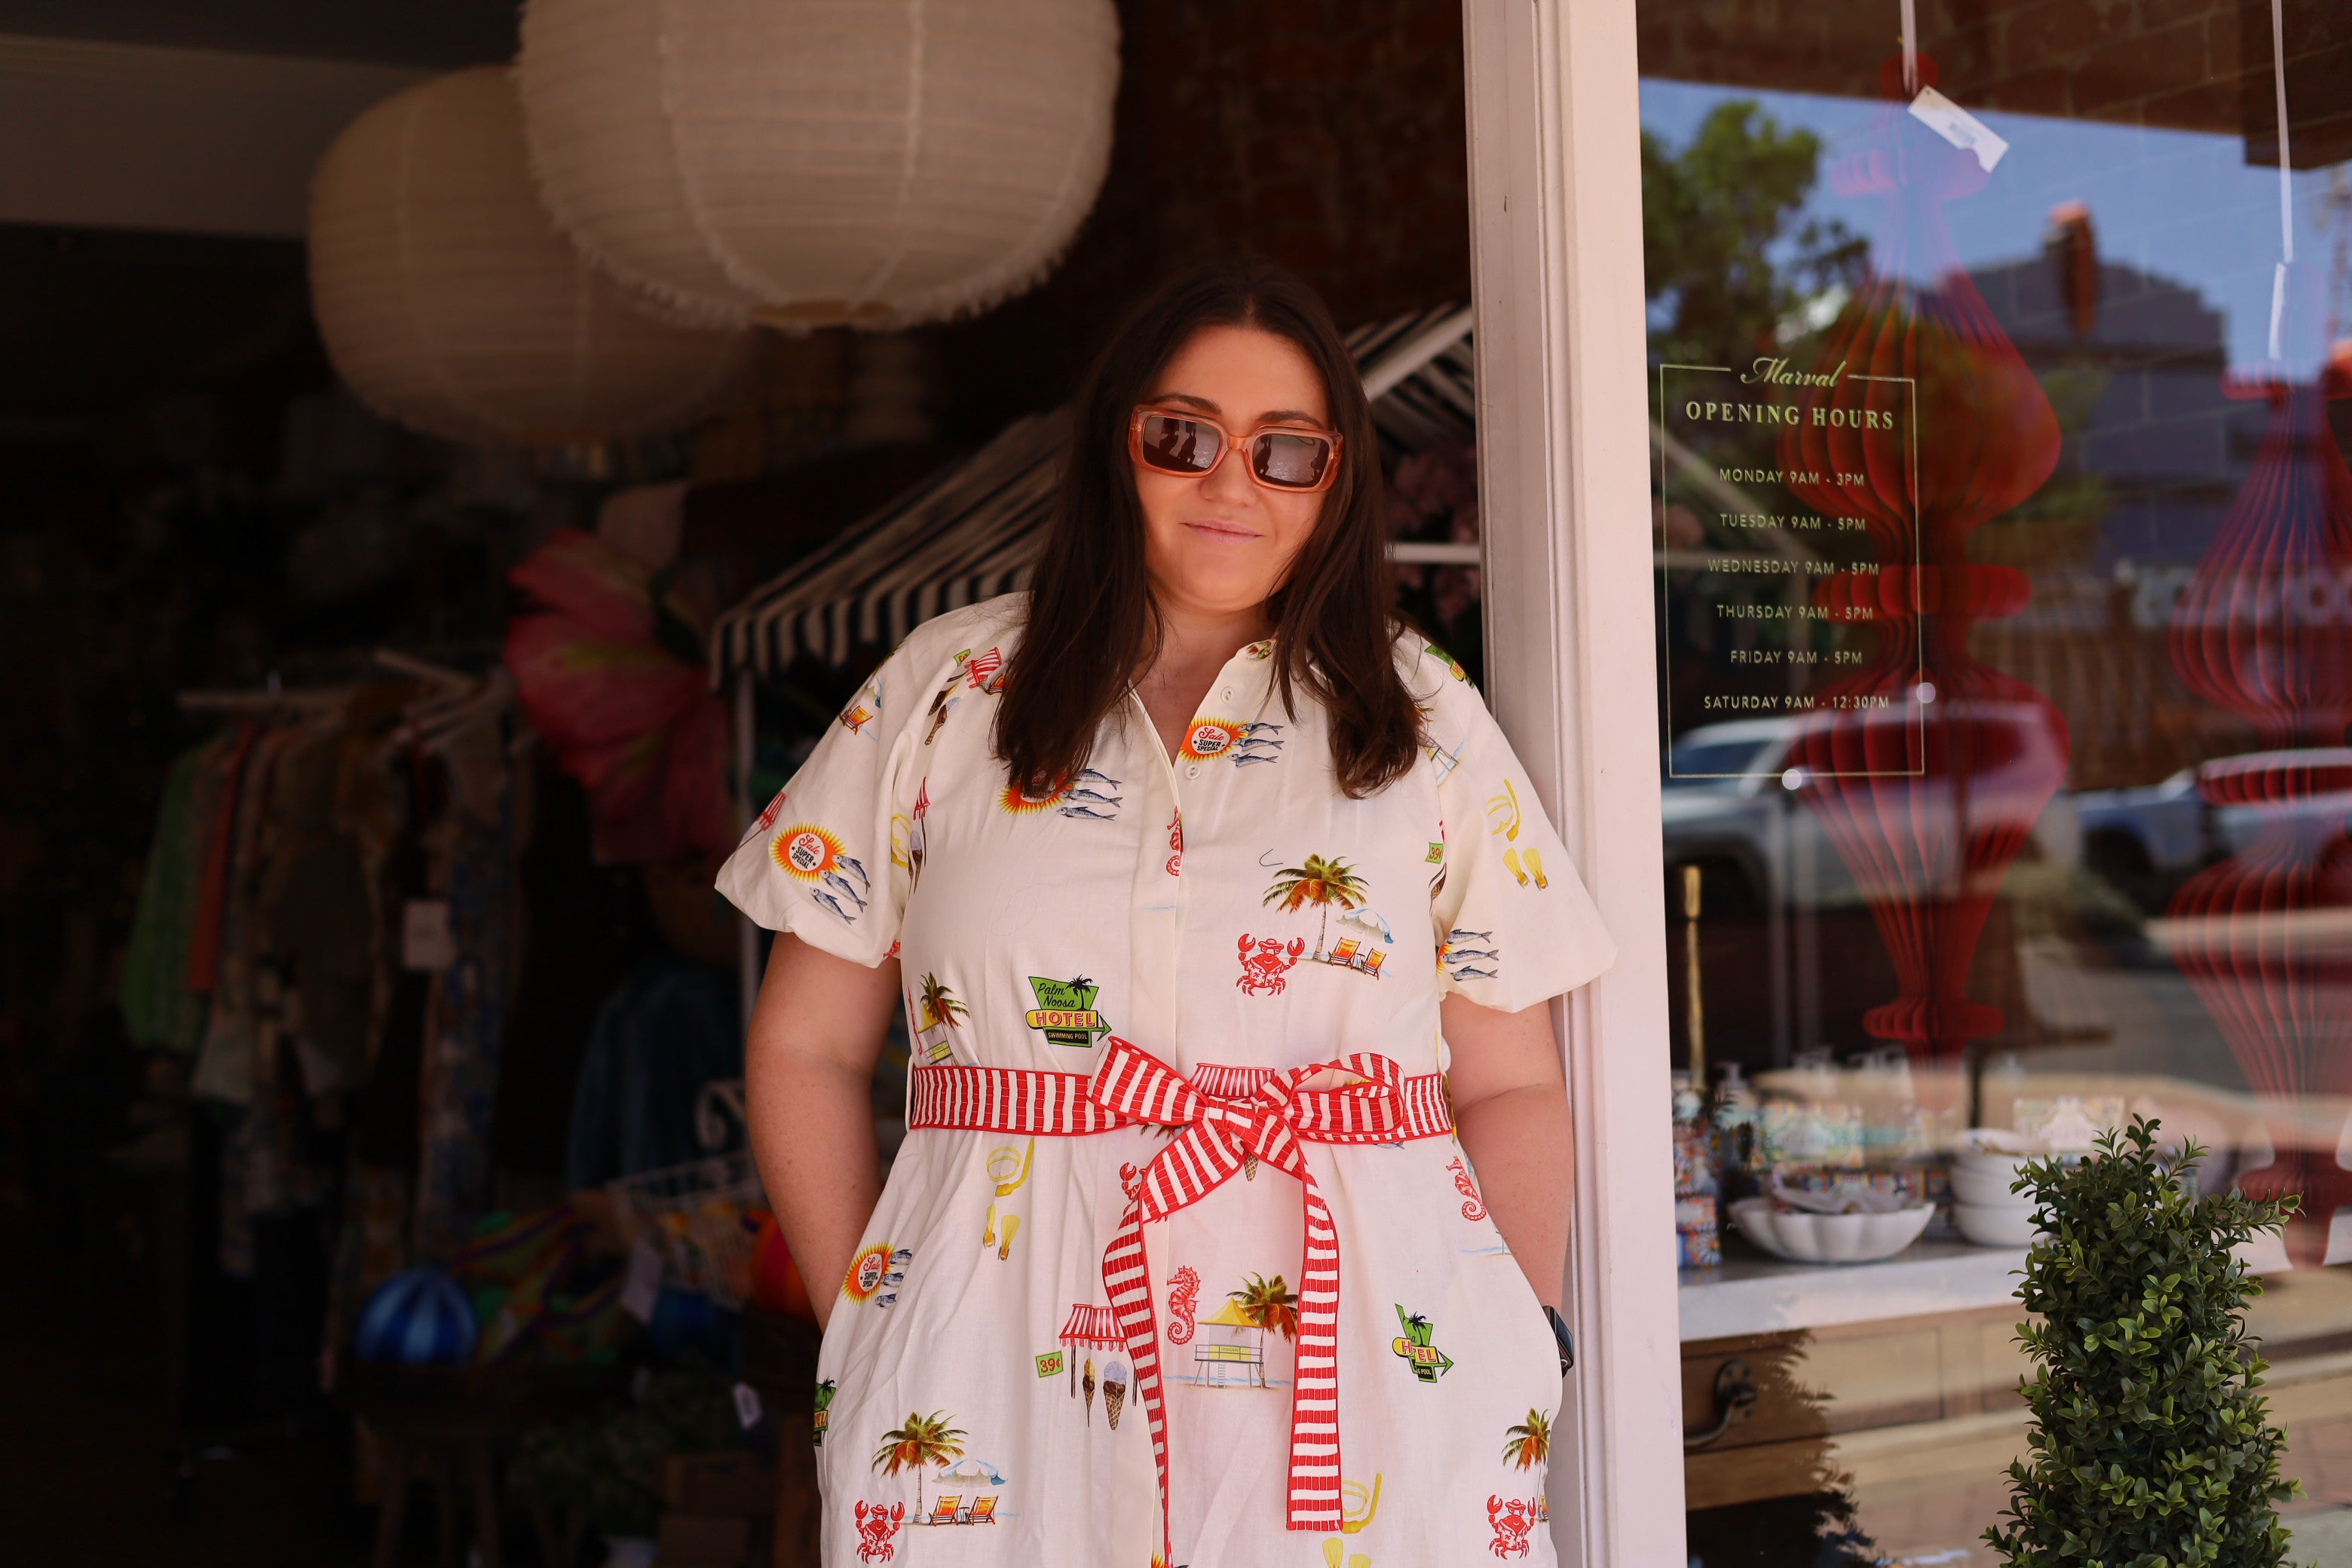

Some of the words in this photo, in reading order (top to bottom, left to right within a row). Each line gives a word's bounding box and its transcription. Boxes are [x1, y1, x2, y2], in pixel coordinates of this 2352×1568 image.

[1740, 357, 1847, 387] Marval
[1686, 401, 1799, 425] OPENING
[1812, 406, 1894, 430] HOURS
[1720, 468, 1784, 482] MONDAY
[1790, 471, 1820, 485] 9AM
[1836, 473, 1864, 486] 3PM
[1720, 513, 1785, 528] TUESDAY
[1791, 516, 1821, 529] 9AM
[1838, 517, 1866, 531] 5PM
[1707, 559, 1799, 574] WEDNESDAY
[1805, 562, 1835, 574] 9AM
[1851, 562, 1879, 575] 5PM
[1717, 605, 1792, 619] THURSDAY
[1798, 606, 1828, 620] 9AM
[1845, 606, 1873, 620] 5PM
[1730, 650, 1781, 664] FRIDAY
[1787, 651, 1818, 664] 9AM
[1834, 651, 1862, 664] 5PM
[1704, 695, 1778, 709] SATURDAY
[1784, 696, 1815, 709] 9AM
[1833, 696, 1889, 709] 12:30PM
[1199, 727, 1224, 741] Sale
[1199, 739, 1221, 747] SUPER
[798, 835, 820, 855] Sale
[792, 853, 810, 869] SPECIAL
[796, 846, 814, 864] SUPER
[1037, 982, 1064, 996] Palm
[1043, 995, 1076, 1008] Noosa
[1035, 1011, 1095, 1027] HOTEL
[1048, 1031, 1073, 1040] SWIMMING
[1401, 1340, 1436, 1362] HEL
[1040, 1357, 1061, 1374] 39¢
